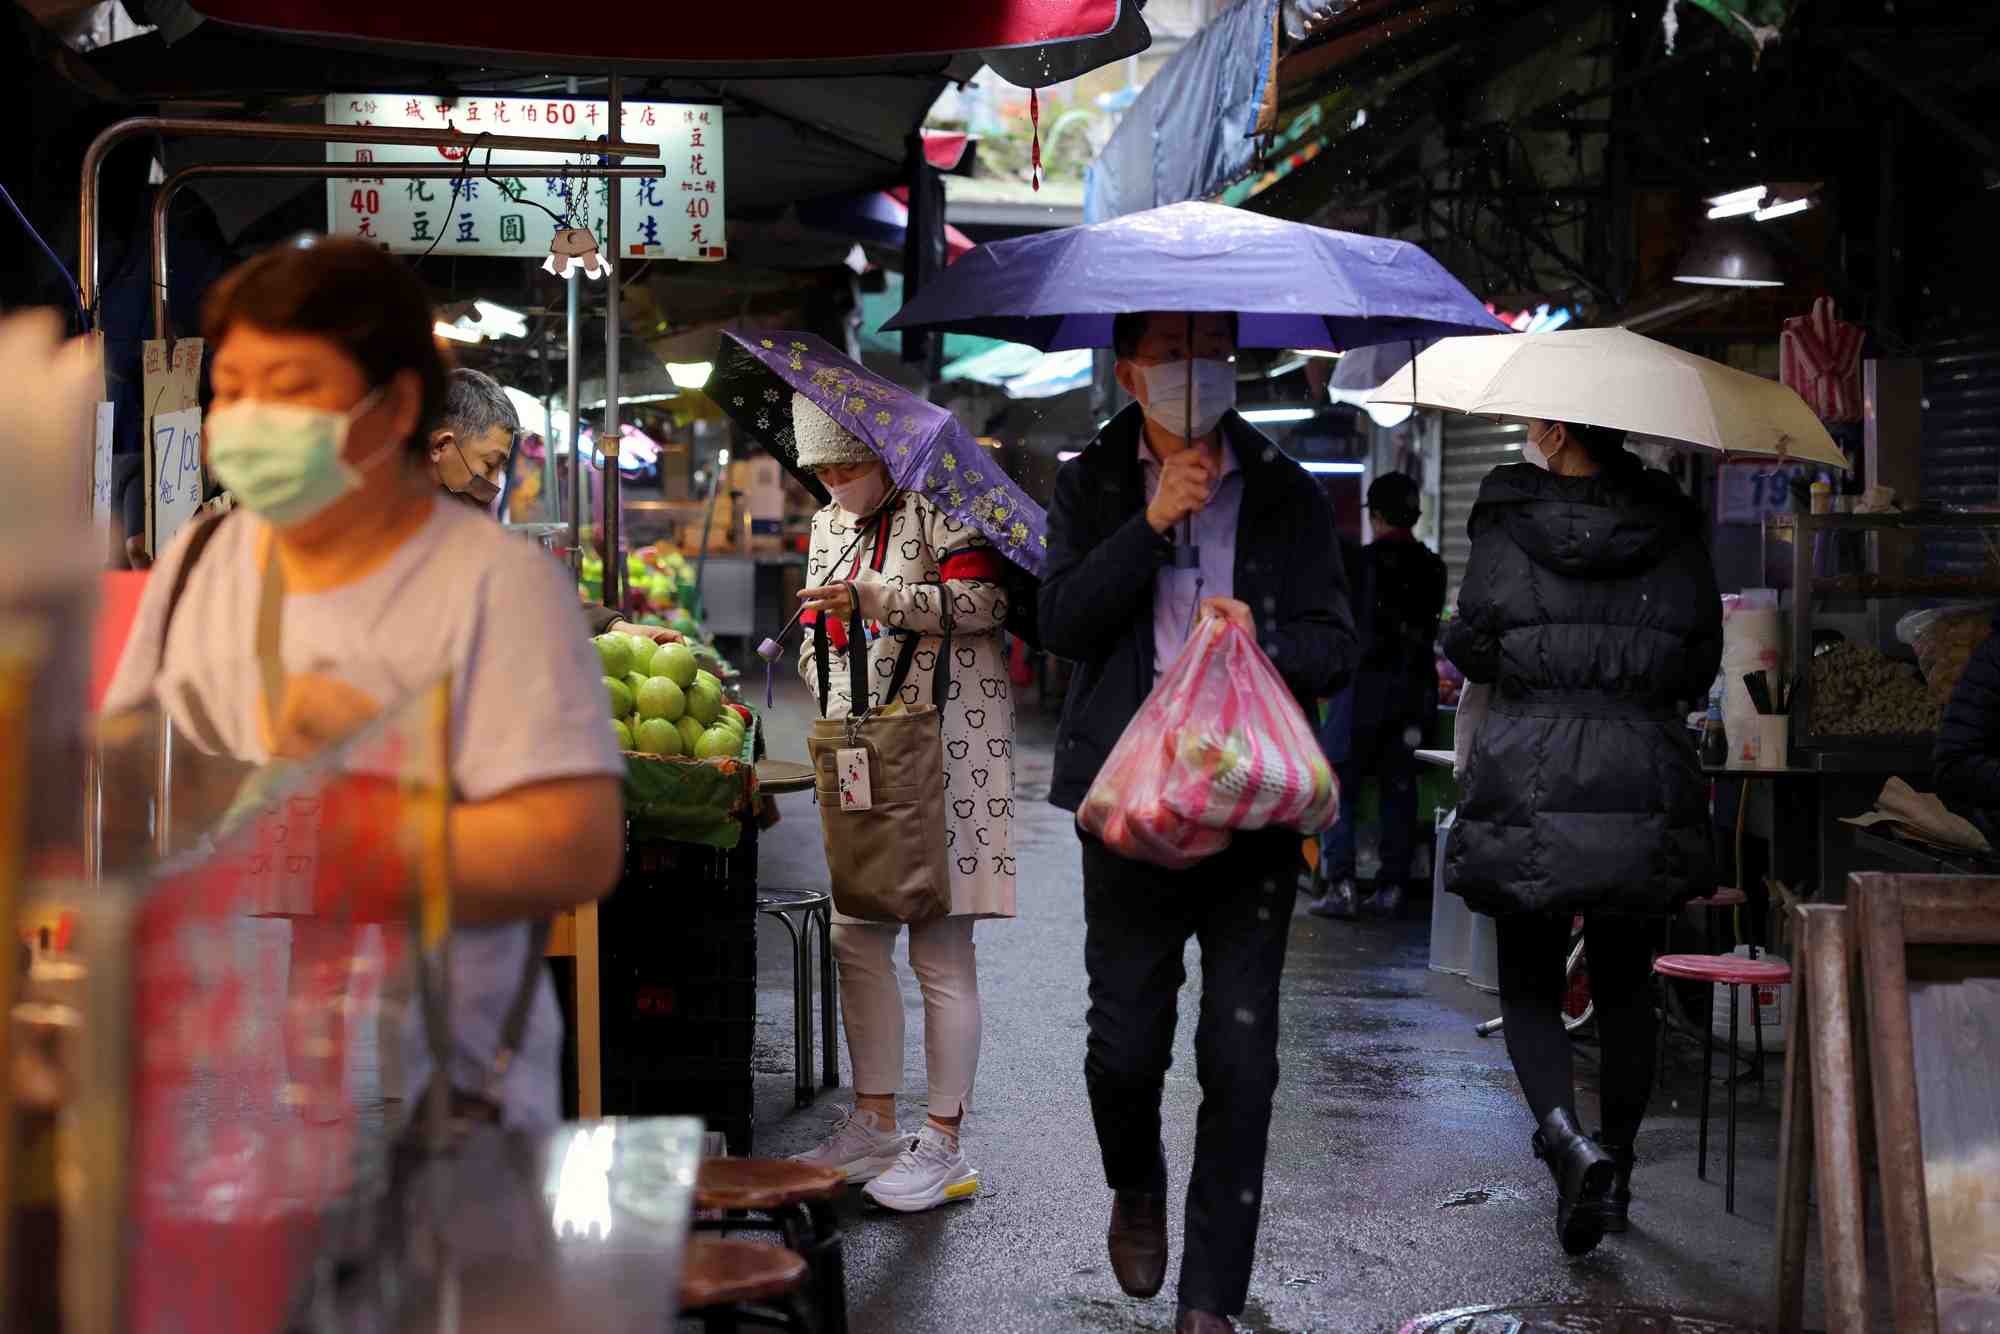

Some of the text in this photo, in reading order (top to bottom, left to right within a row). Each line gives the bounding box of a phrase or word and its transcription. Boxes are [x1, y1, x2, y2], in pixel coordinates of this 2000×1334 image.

[690, 127, 708, 176] 豆花
[350, 189, 379, 214] 40
[685, 197, 709, 219] 40
[357, 216, 377, 238] 元
[689, 223, 708, 245] 元
